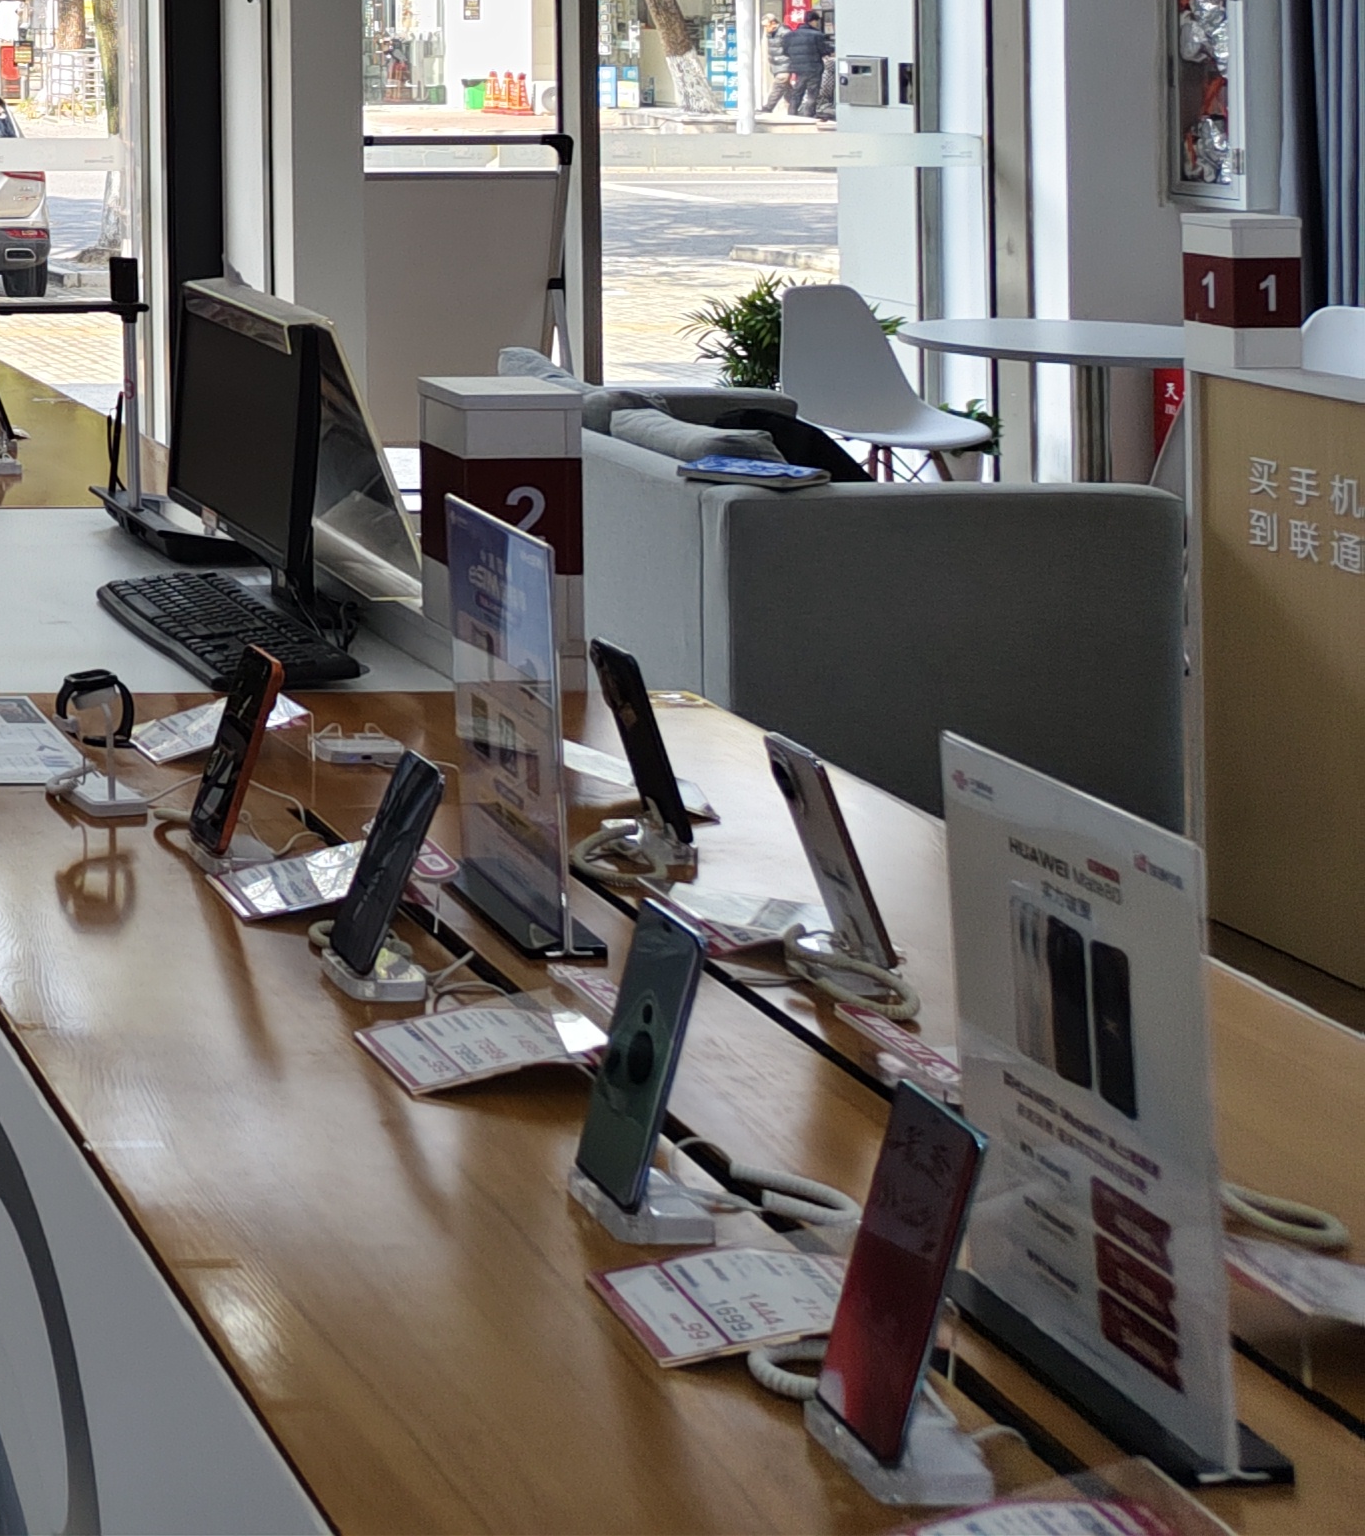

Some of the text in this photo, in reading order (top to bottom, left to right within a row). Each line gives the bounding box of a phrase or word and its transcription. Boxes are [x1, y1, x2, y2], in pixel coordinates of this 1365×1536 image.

[1201, 270, 1217, 310] 1
[1259, 273, 1278, 314] 1
[1249, 456, 1365, 520] 买手机
[503, 485, 548, 542] 2
[1249, 507, 1365, 577] 到联通
[1008, 836, 1070, 880] HUAWEI
